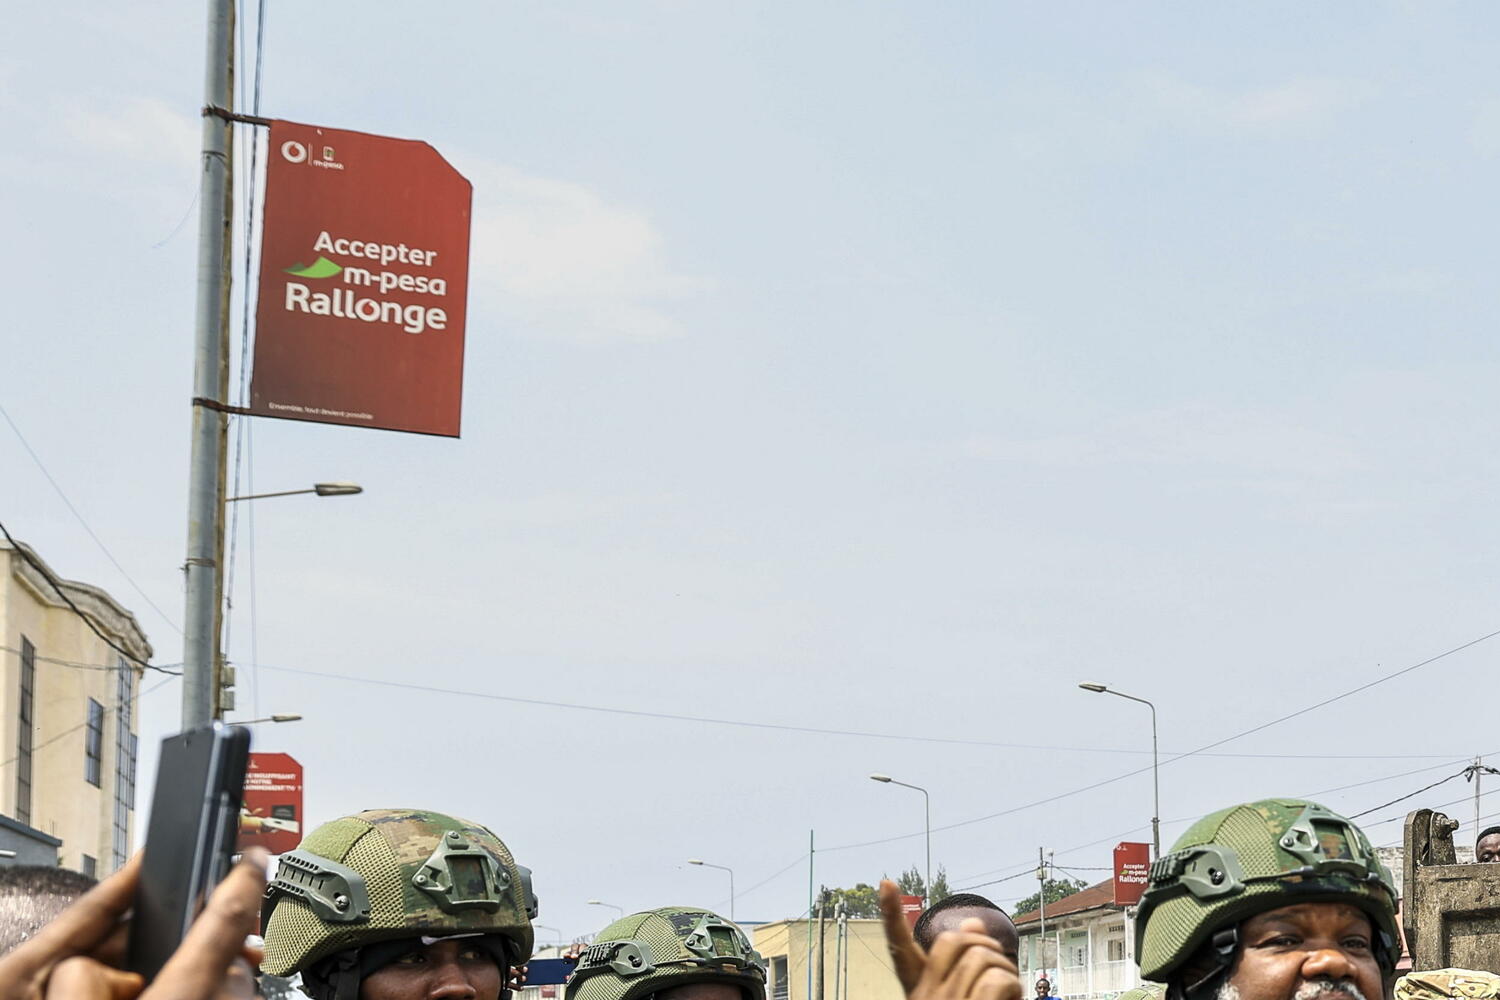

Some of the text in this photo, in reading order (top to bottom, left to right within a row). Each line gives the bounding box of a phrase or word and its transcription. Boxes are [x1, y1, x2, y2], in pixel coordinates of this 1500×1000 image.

[313, 230, 437, 266] Accepter
[343, 266, 447, 296] m-pesa
[285, 281, 448, 334] Rallonge
